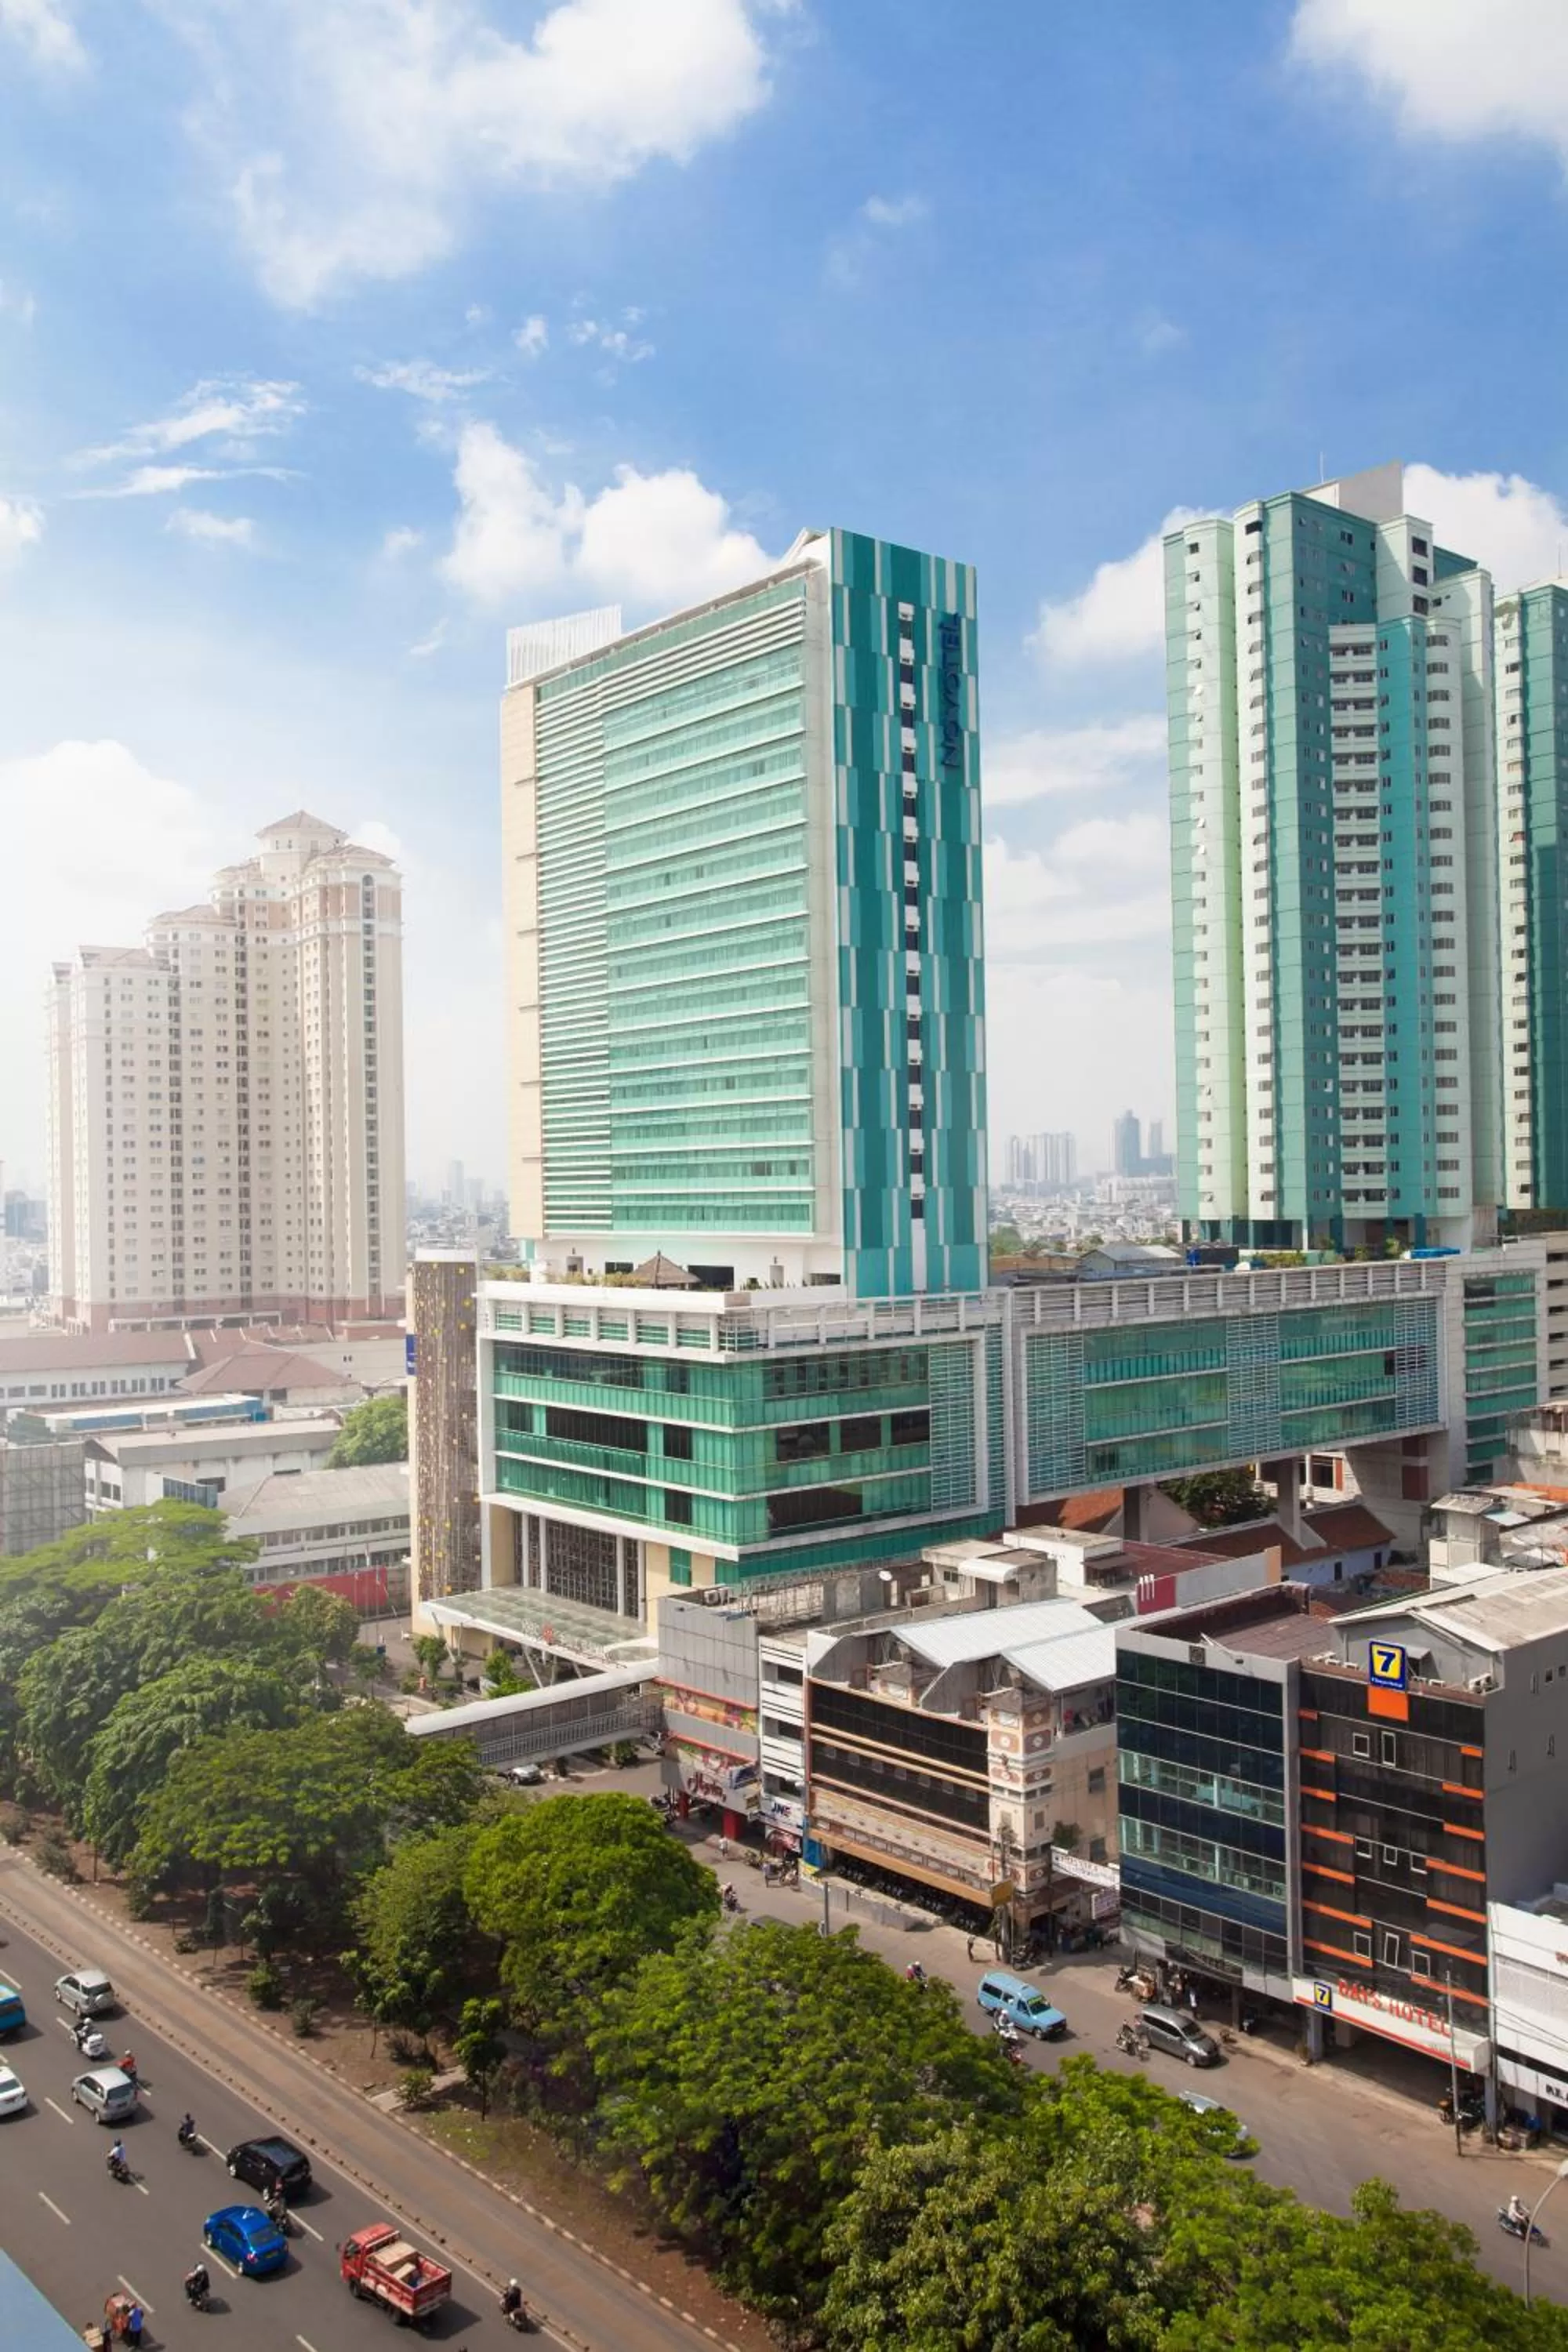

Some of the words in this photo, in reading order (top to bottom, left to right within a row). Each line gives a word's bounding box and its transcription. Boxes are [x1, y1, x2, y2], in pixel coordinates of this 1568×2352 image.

[938, 613, 960, 768] NOVOTEL
[1377, 1650, 1396, 1672] 7
[1317, 1987, 1327, 2002] 7
[1388, 1999, 1451, 2037] HOTEL
